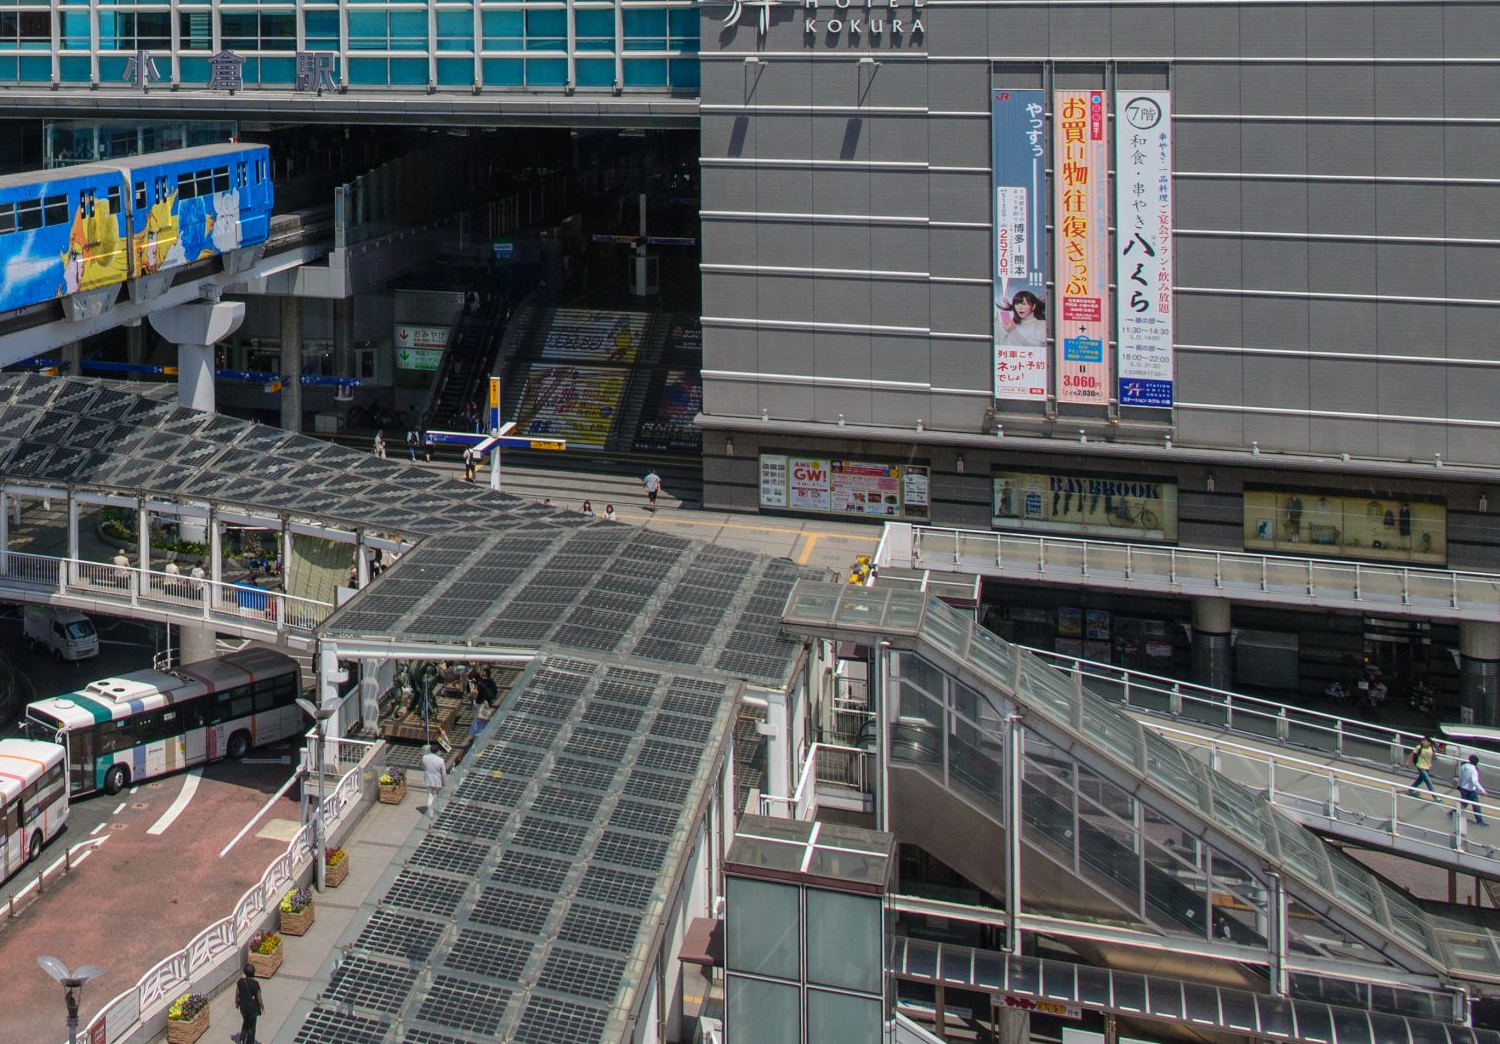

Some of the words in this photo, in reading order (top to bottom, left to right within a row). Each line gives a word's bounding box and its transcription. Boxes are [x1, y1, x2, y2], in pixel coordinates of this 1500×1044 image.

[805, 19, 925, 33] KOKURA
[996, 92, 1010, 101] JR
[1128, 106, 1156, 122] 7階
[1061, 97, 1089, 296] お買い物往復きっぷ
[997, 361, 1045, 371] ネット予約
[794, 468, 827, 482] GW!
